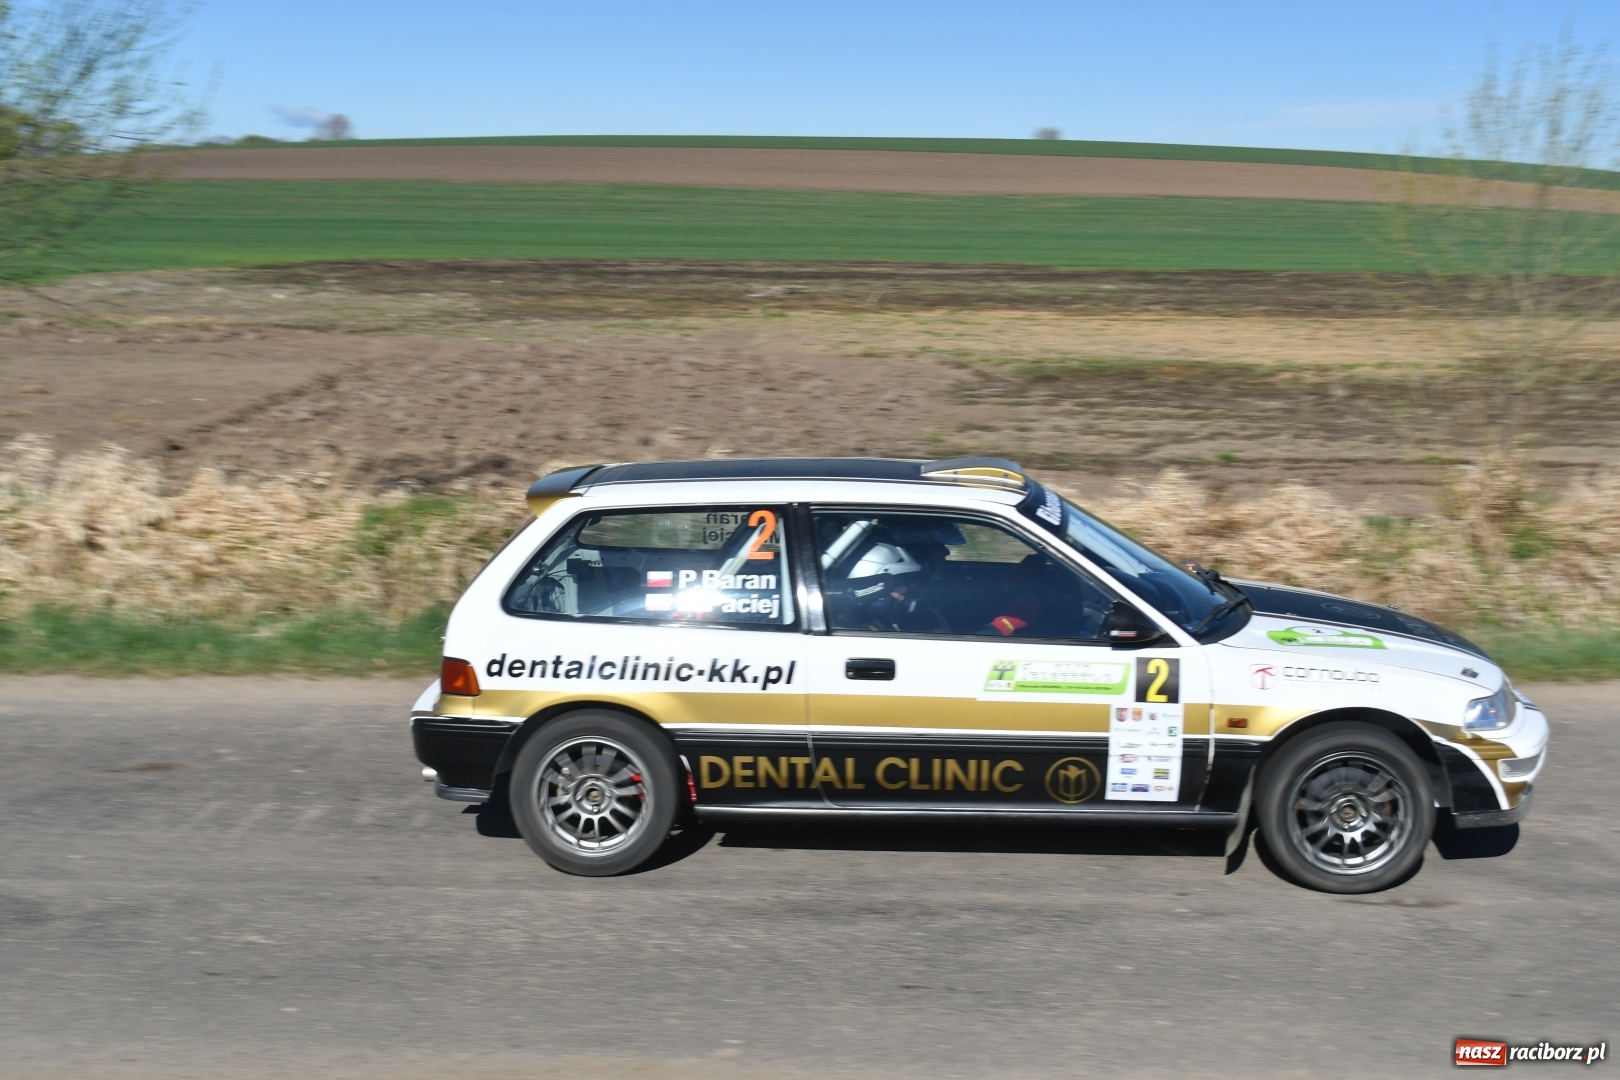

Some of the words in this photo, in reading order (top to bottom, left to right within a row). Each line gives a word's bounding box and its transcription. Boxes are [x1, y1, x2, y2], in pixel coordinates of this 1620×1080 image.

[747, 510, 777, 560] 2
[678, 569, 777, 590] P.Baran
[1146, 658, 1170, 703] 2
[701, 755, 865, 790] DENTAL
[874, 757, 1025, 793] CLINIC
